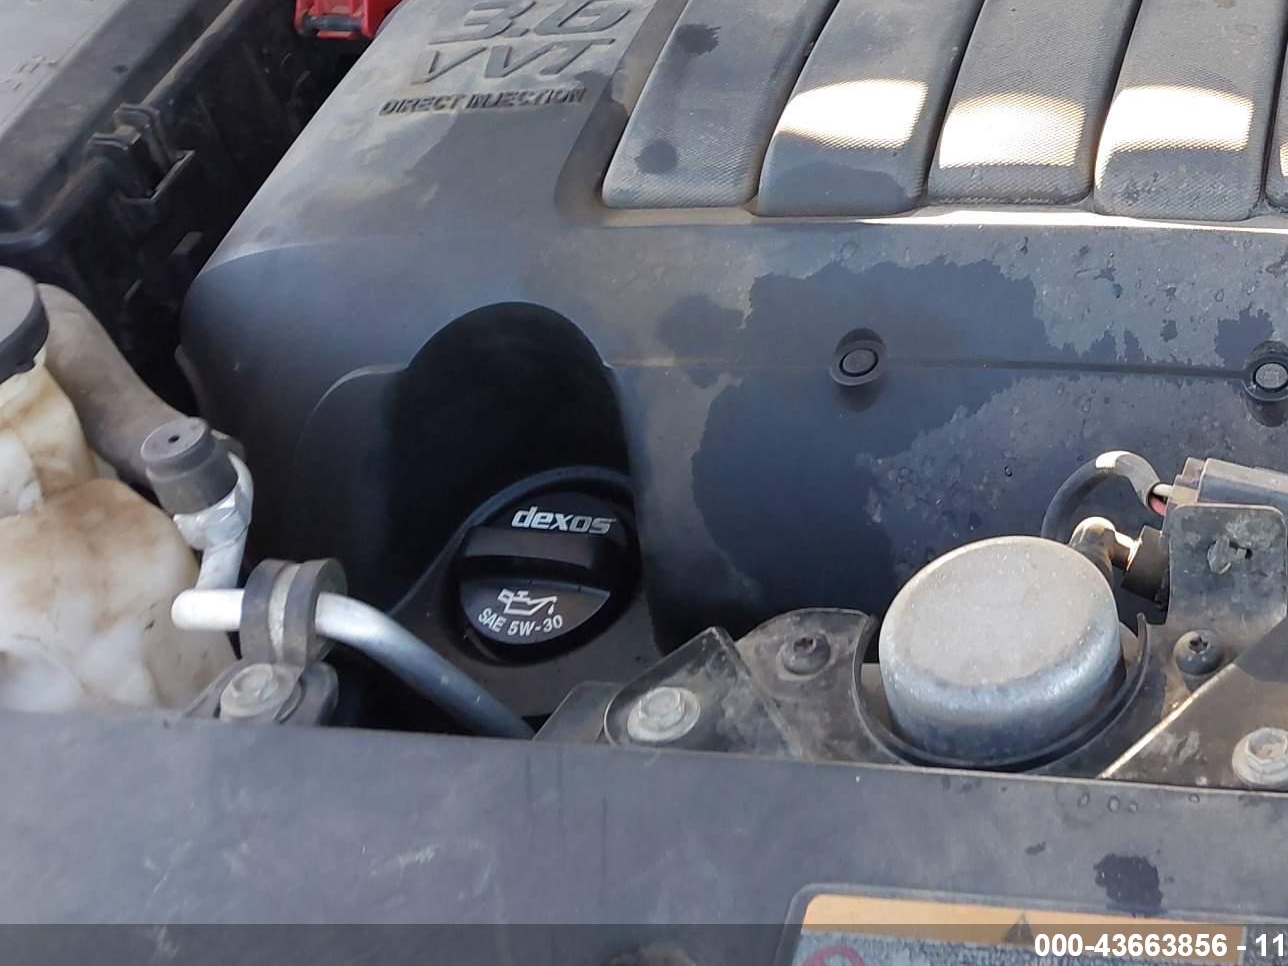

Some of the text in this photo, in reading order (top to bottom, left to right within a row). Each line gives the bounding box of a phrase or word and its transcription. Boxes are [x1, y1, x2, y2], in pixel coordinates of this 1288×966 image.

[411, 38, 616, 85] VVT
[378, 87, 588, 117] DIRECT INJECTION
[511, 506, 616, 534] dexos
[478, 608, 564, 637] SAE 5W-30
